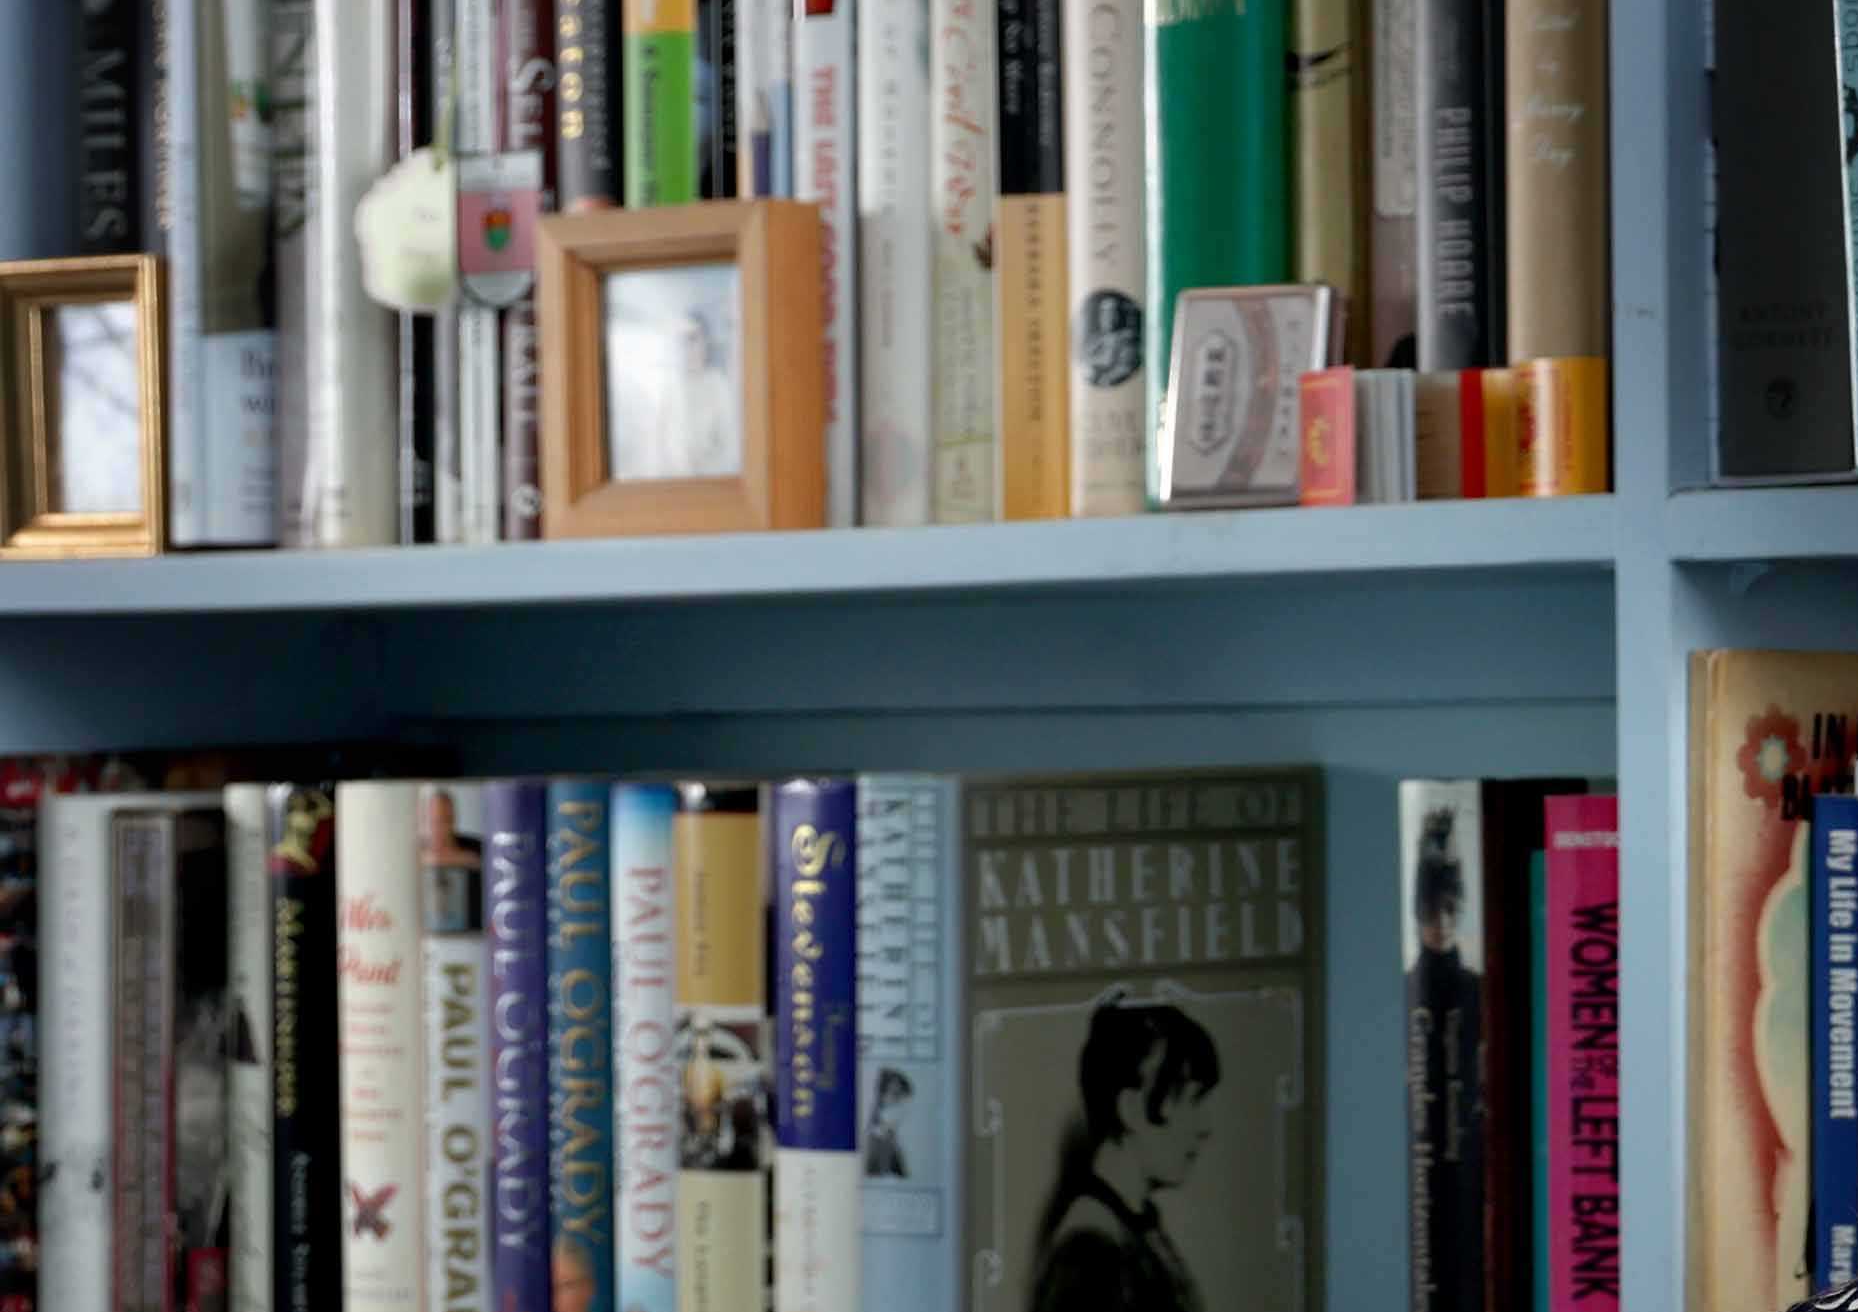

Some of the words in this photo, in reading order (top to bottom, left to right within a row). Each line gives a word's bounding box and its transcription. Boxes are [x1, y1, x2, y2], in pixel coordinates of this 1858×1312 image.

[977, 839, 1298, 909] KATHERINE
[1828, 828, 1856, 868] My
[1828, 875, 1858, 927] Life
[974, 900, 1305, 976] MANSFIELD
[1829, 934, 1858, 962] In
[439, 961, 479, 1104] PAUL
[1829, 964, 1858, 1119] Movement
